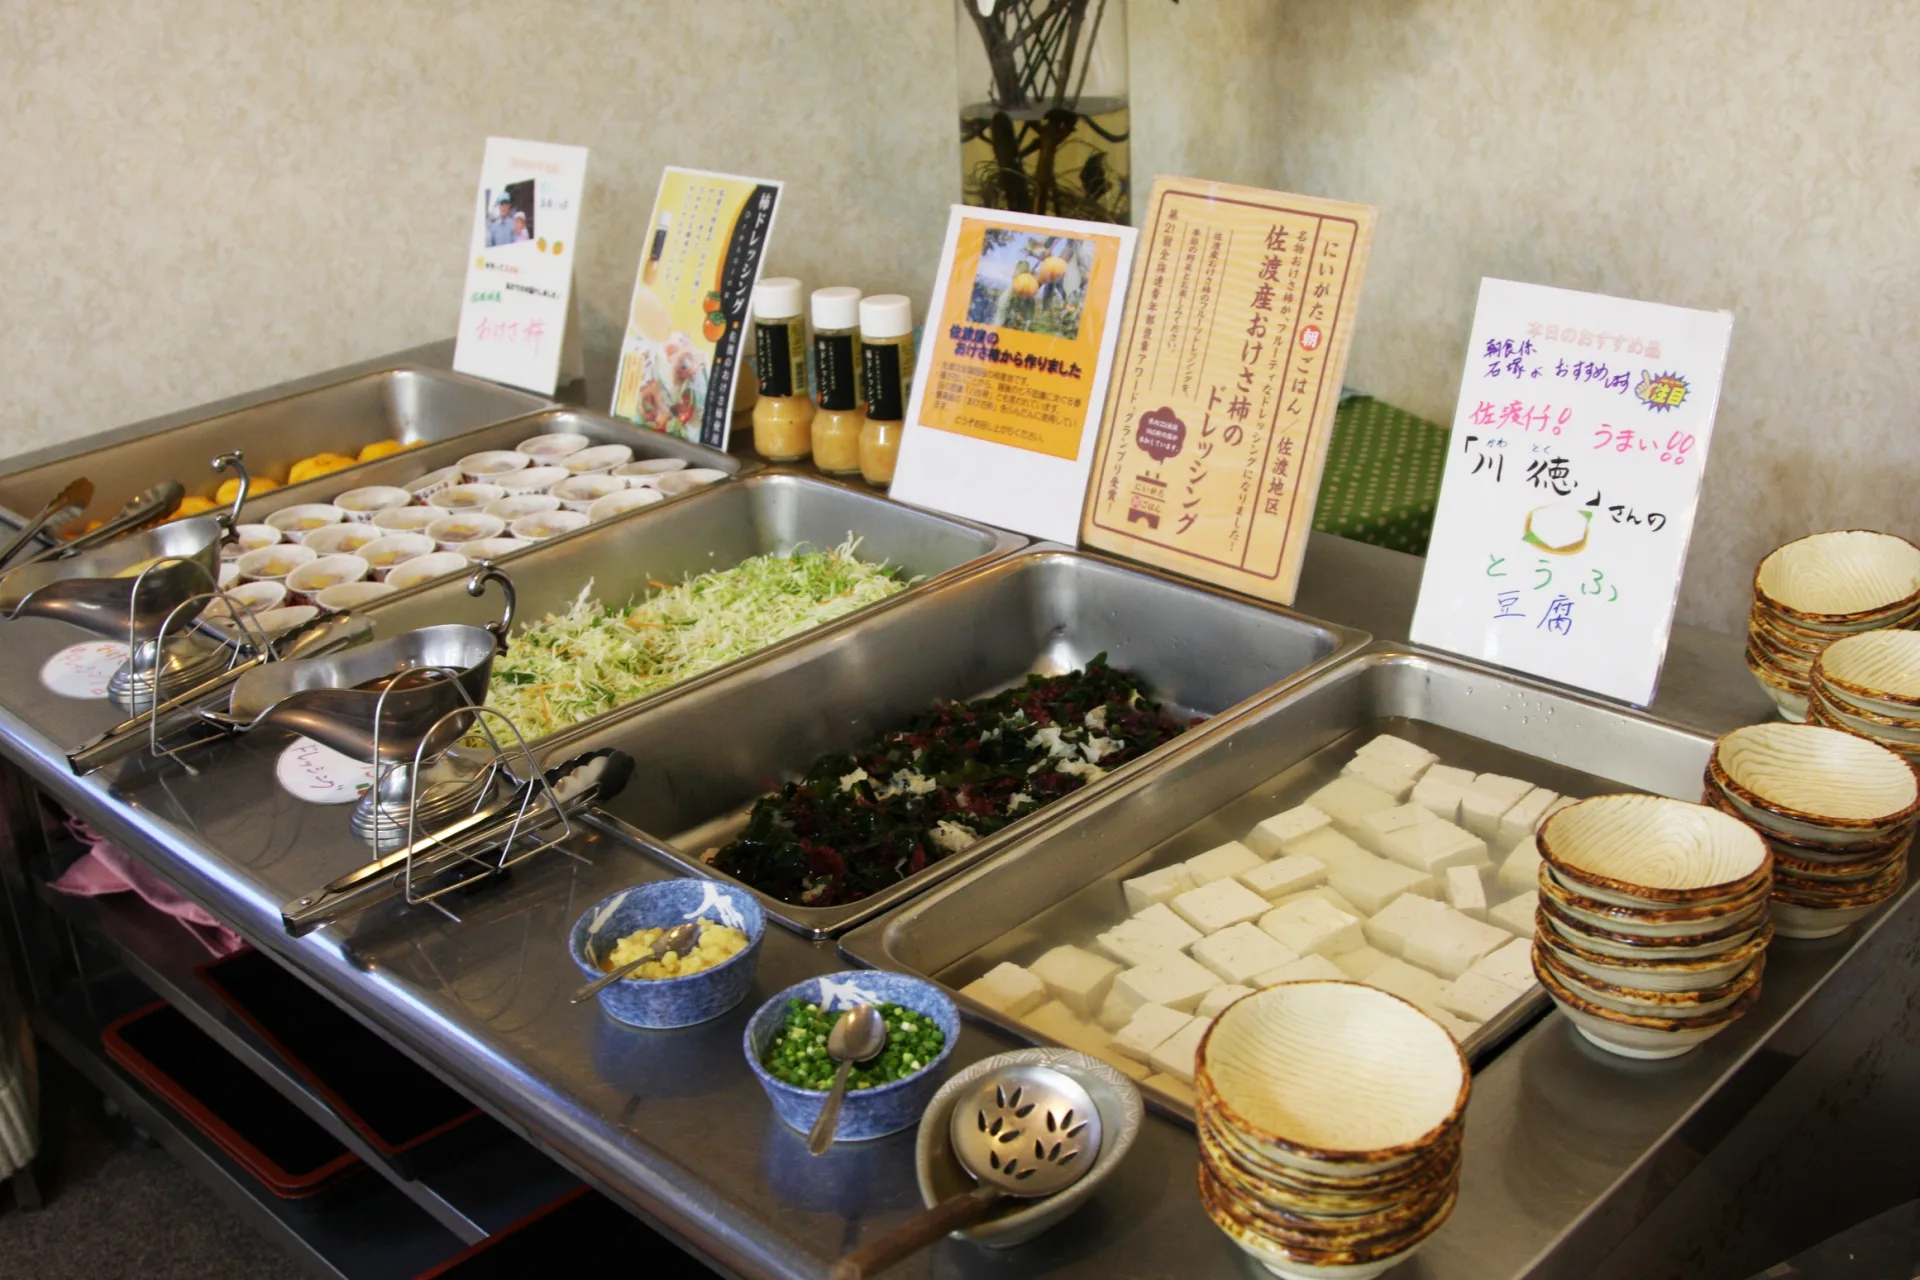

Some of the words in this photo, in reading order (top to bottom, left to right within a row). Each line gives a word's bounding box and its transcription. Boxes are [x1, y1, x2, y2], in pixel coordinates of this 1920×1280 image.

[1222, 223, 1288, 448] 佐渡産おけさ柿の
[1526, 320, 1663, 360] 本日のおすすめ品
[1176, 385, 1227, 535] ドレッシング
[1493, 590, 1576, 636] 豆腐
